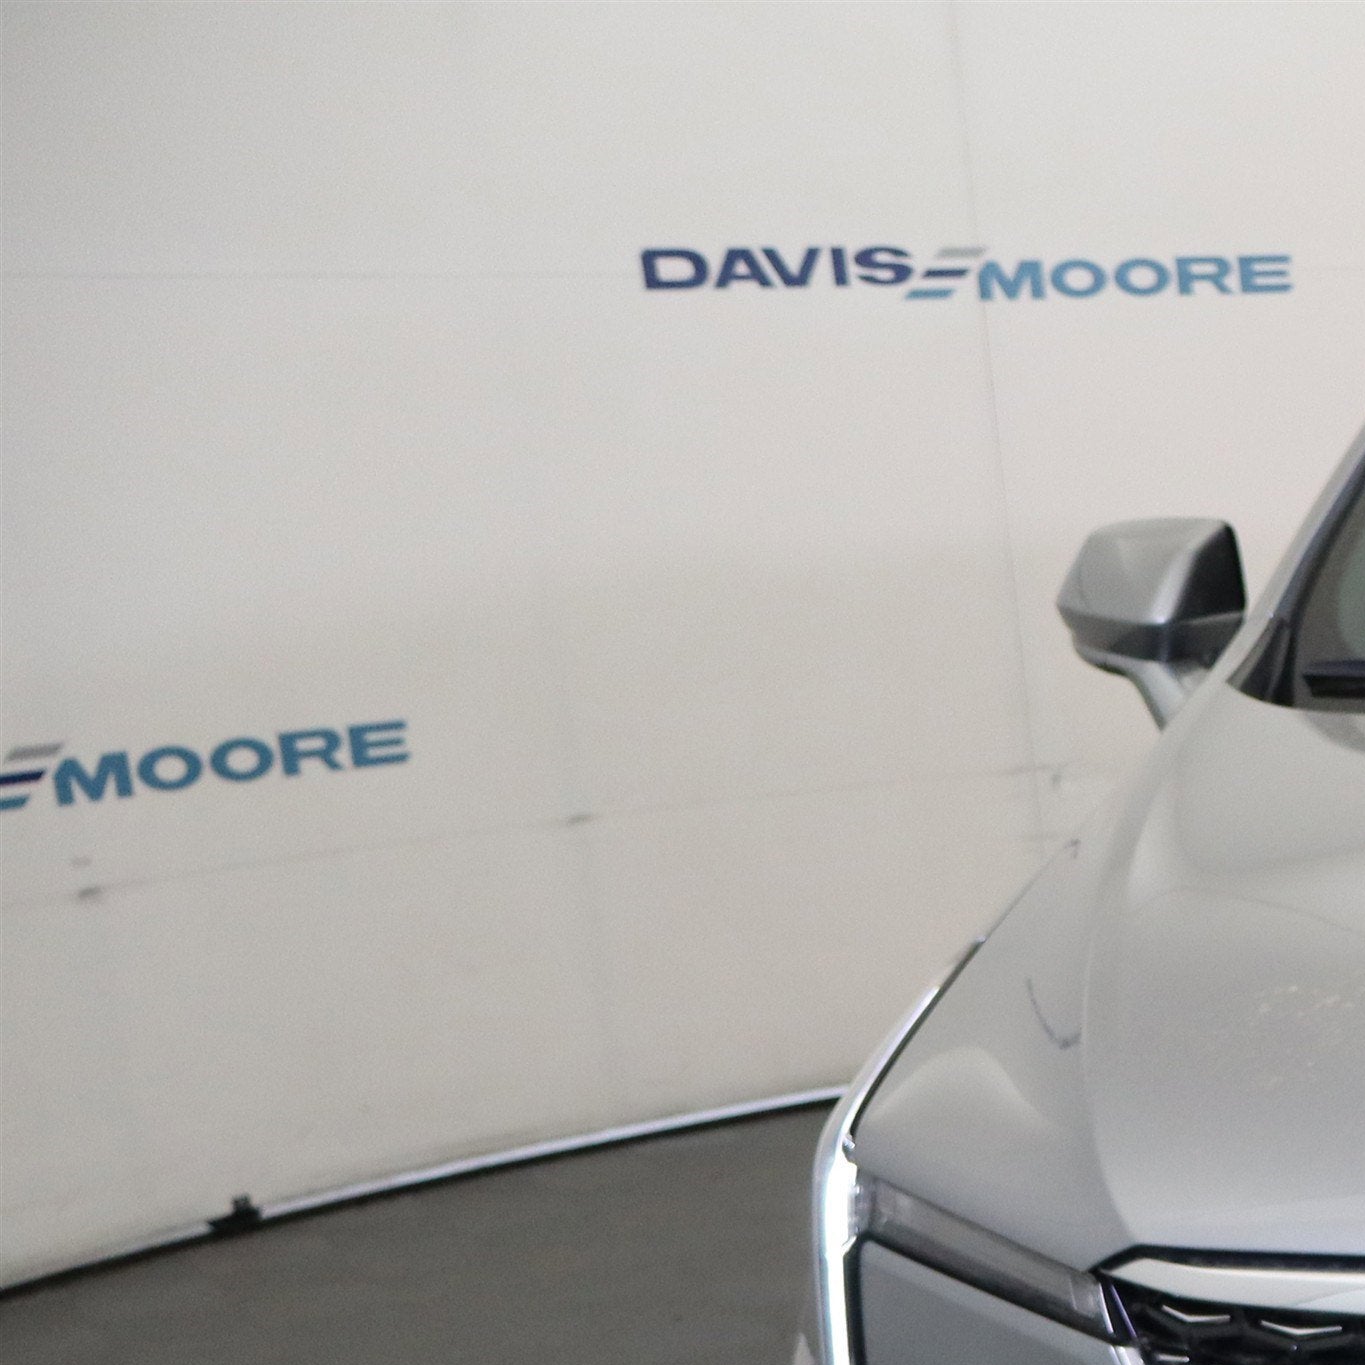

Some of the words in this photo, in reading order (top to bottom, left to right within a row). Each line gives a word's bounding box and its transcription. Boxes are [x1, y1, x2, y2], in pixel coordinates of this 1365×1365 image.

[640, 245, 915, 290] DAVIS
[977, 252, 1294, 301] MOORE
[53, 718, 411, 808] MOORE
